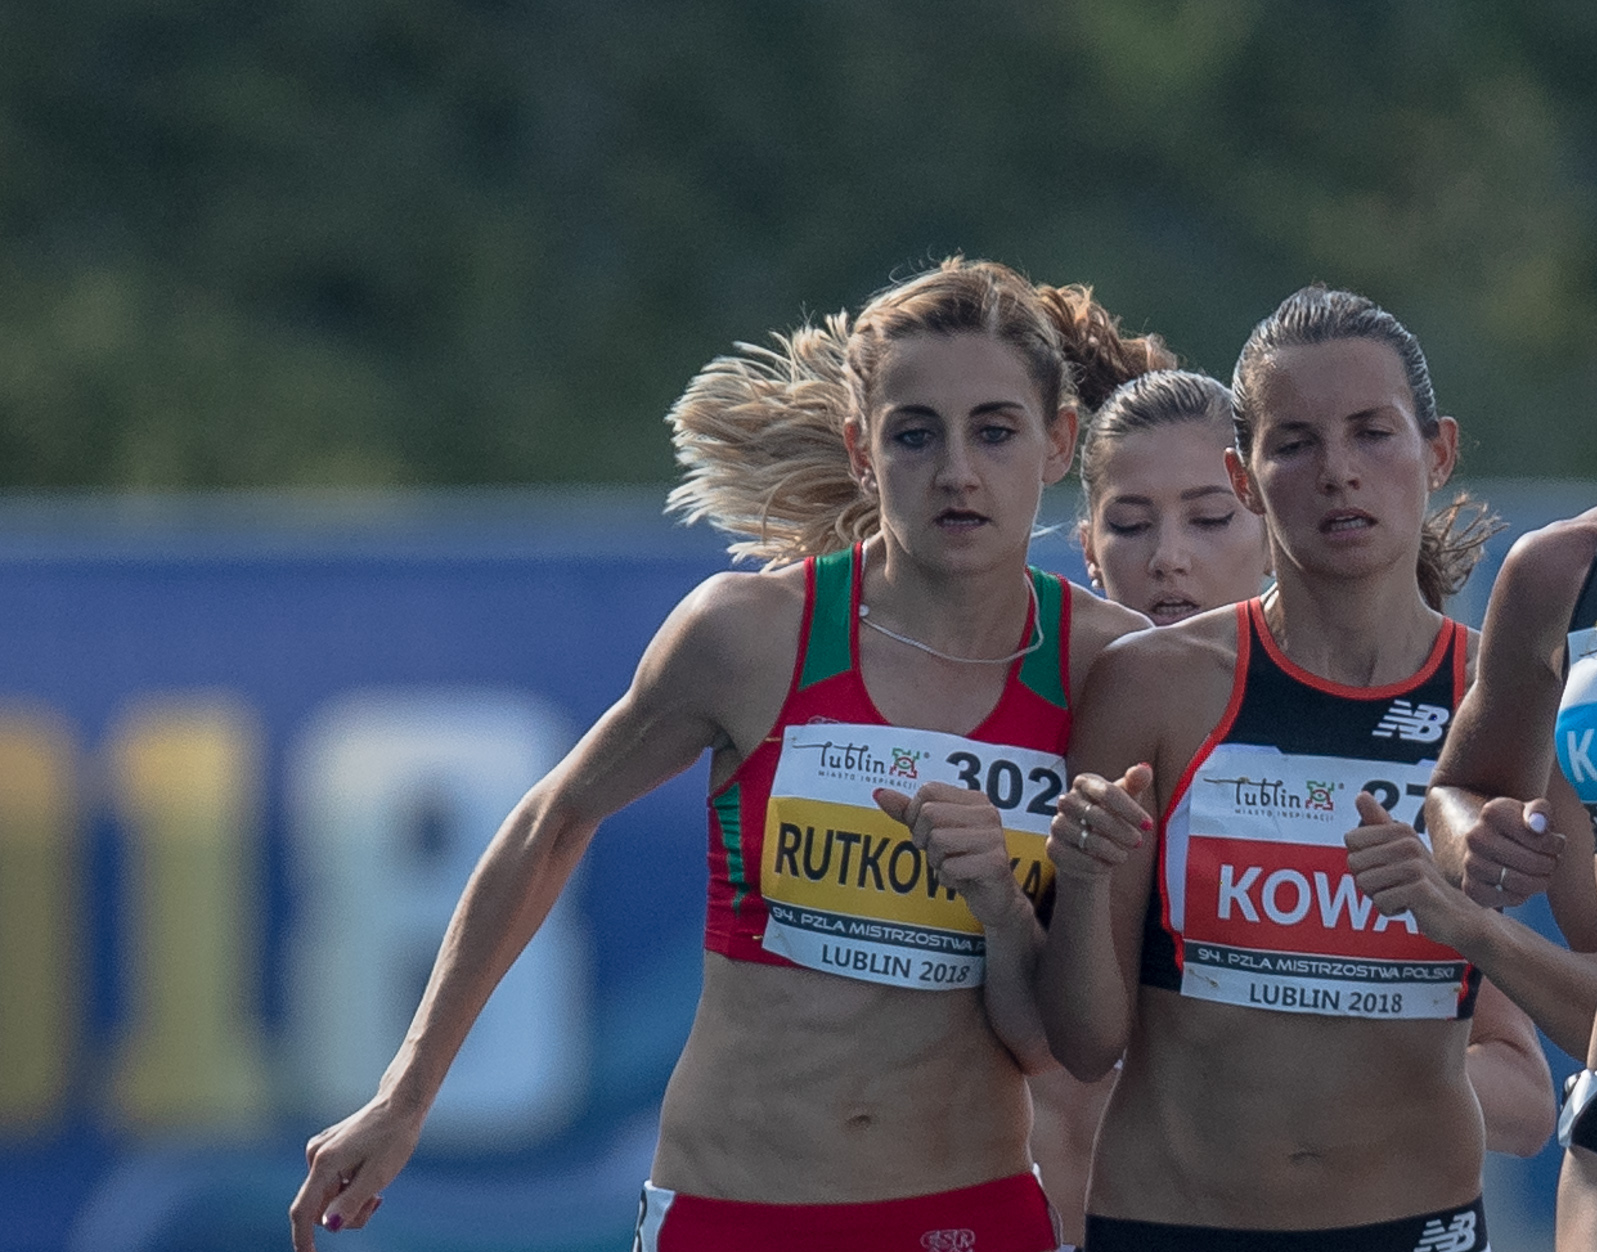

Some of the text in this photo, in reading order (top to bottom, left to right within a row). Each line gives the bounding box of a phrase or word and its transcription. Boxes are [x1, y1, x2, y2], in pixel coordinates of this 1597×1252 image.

[946, 751, 1063, 816] 302
[774, 821, 1042, 902] RUTKOA
[773, 906, 798, 924] 94.
[800, 913, 846, 933] PZLA
[849, 921, 973, 952] MISTRZOSTWA
[821, 944, 971, 984] LUBLIN 2018
[1197, 948, 1225, 963] 94.
[1228, 954, 1273, 970] PZLA
[1275, 958, 1400, 979] MISTRZOSTWA
[1249, 982, 1403, 1013] LUBLIN 2018
